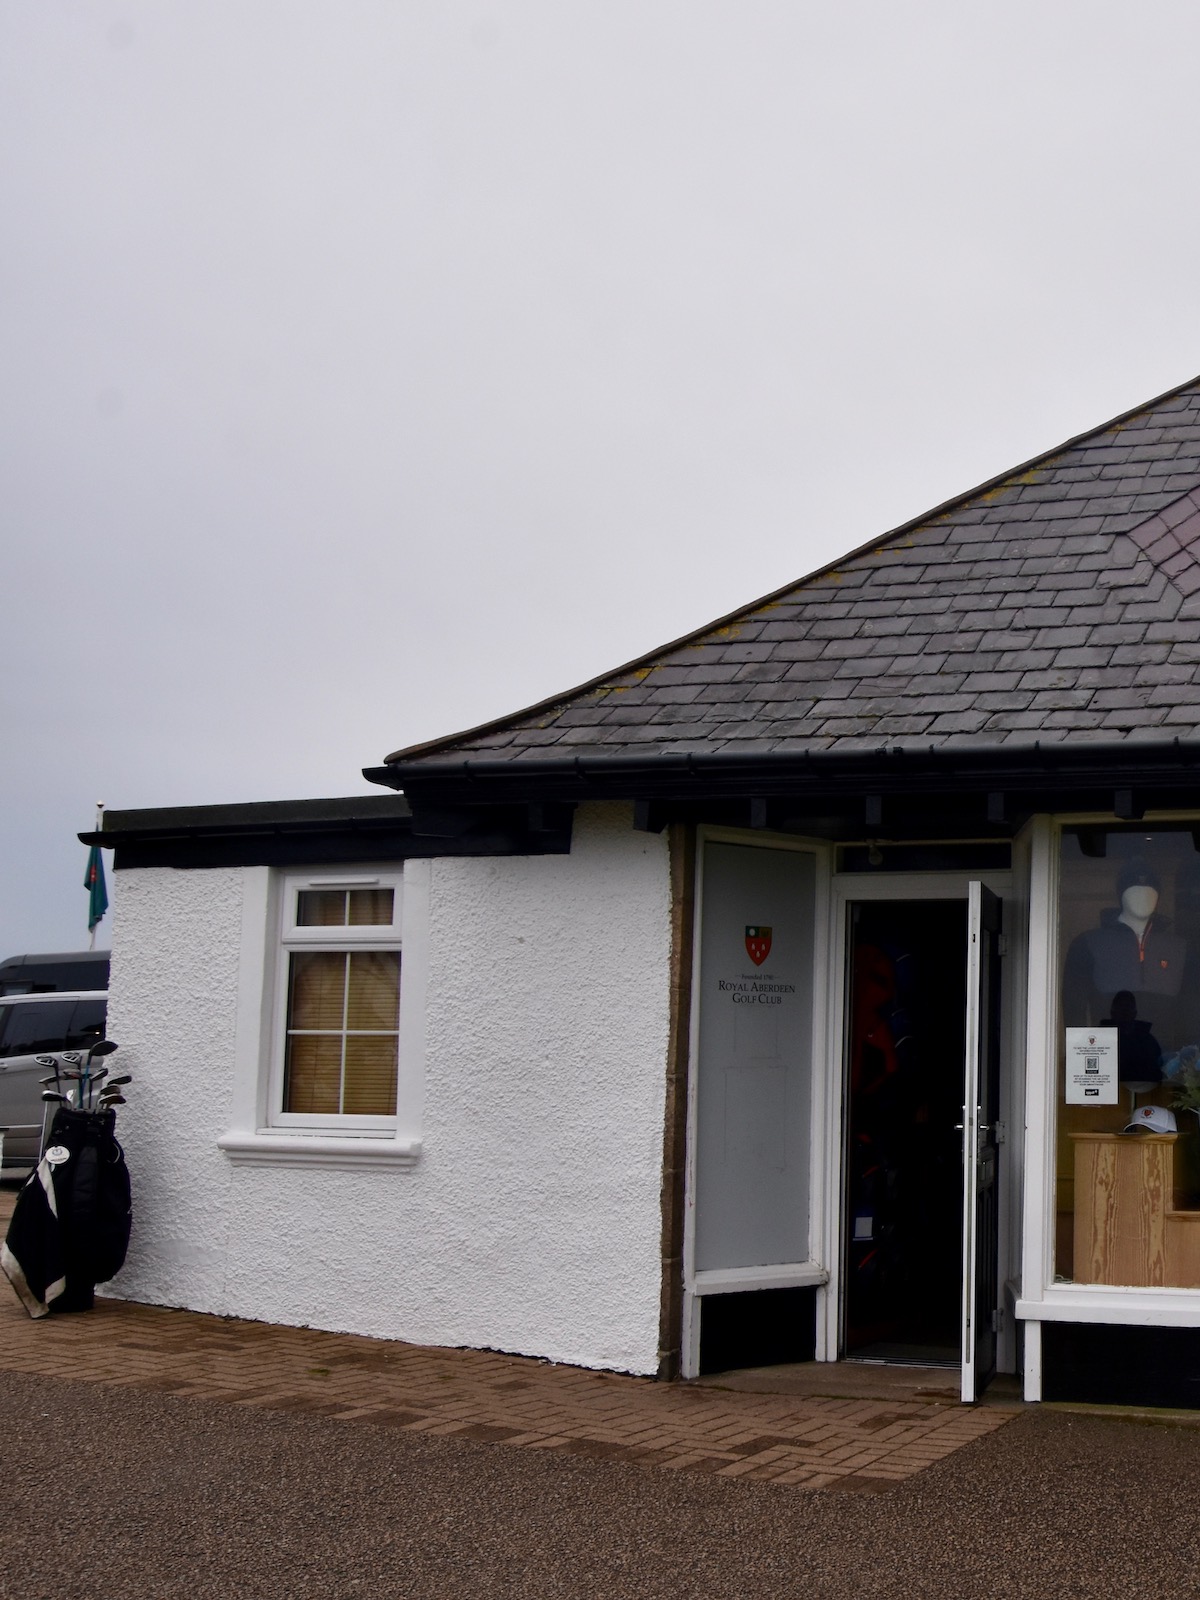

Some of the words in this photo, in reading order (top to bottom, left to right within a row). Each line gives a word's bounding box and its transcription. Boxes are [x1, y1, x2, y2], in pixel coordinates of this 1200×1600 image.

[718, 980, 748, 992] ROYAL
[751, 981, 796, 993] ABERDEEN
[732, 992, 757, 1004] GOLF
[758, 993, 782, 1005] CLUB
